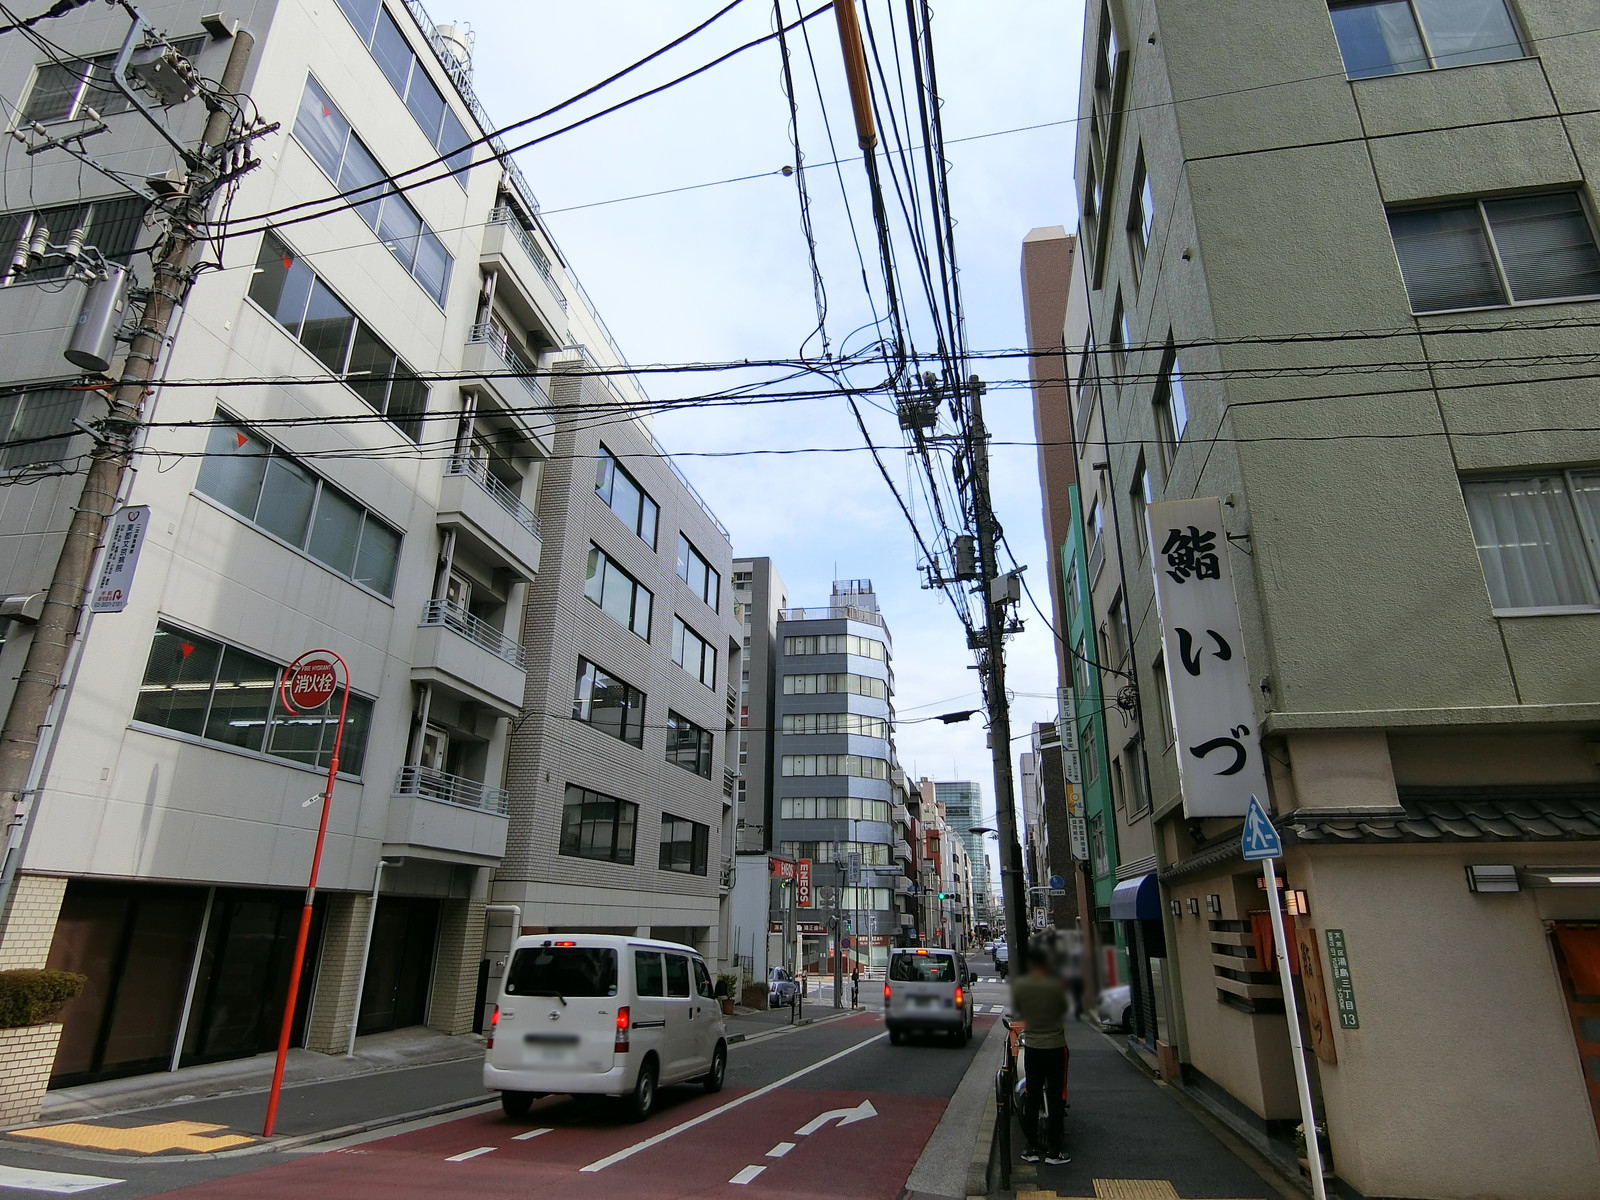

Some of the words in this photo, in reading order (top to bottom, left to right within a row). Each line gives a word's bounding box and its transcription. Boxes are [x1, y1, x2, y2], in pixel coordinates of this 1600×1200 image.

[1161, 525, 1250, 776] 鮨いづ
[294, 672, 334, 693] 消火栓
[781, 861, 794, 877] ENEOS
[800, 864, 809, 902] ENEOS
[1334, 932, 1354, 1010] 文京区湯島三丁目
[1342, 1014, 1356, 1025] 13
